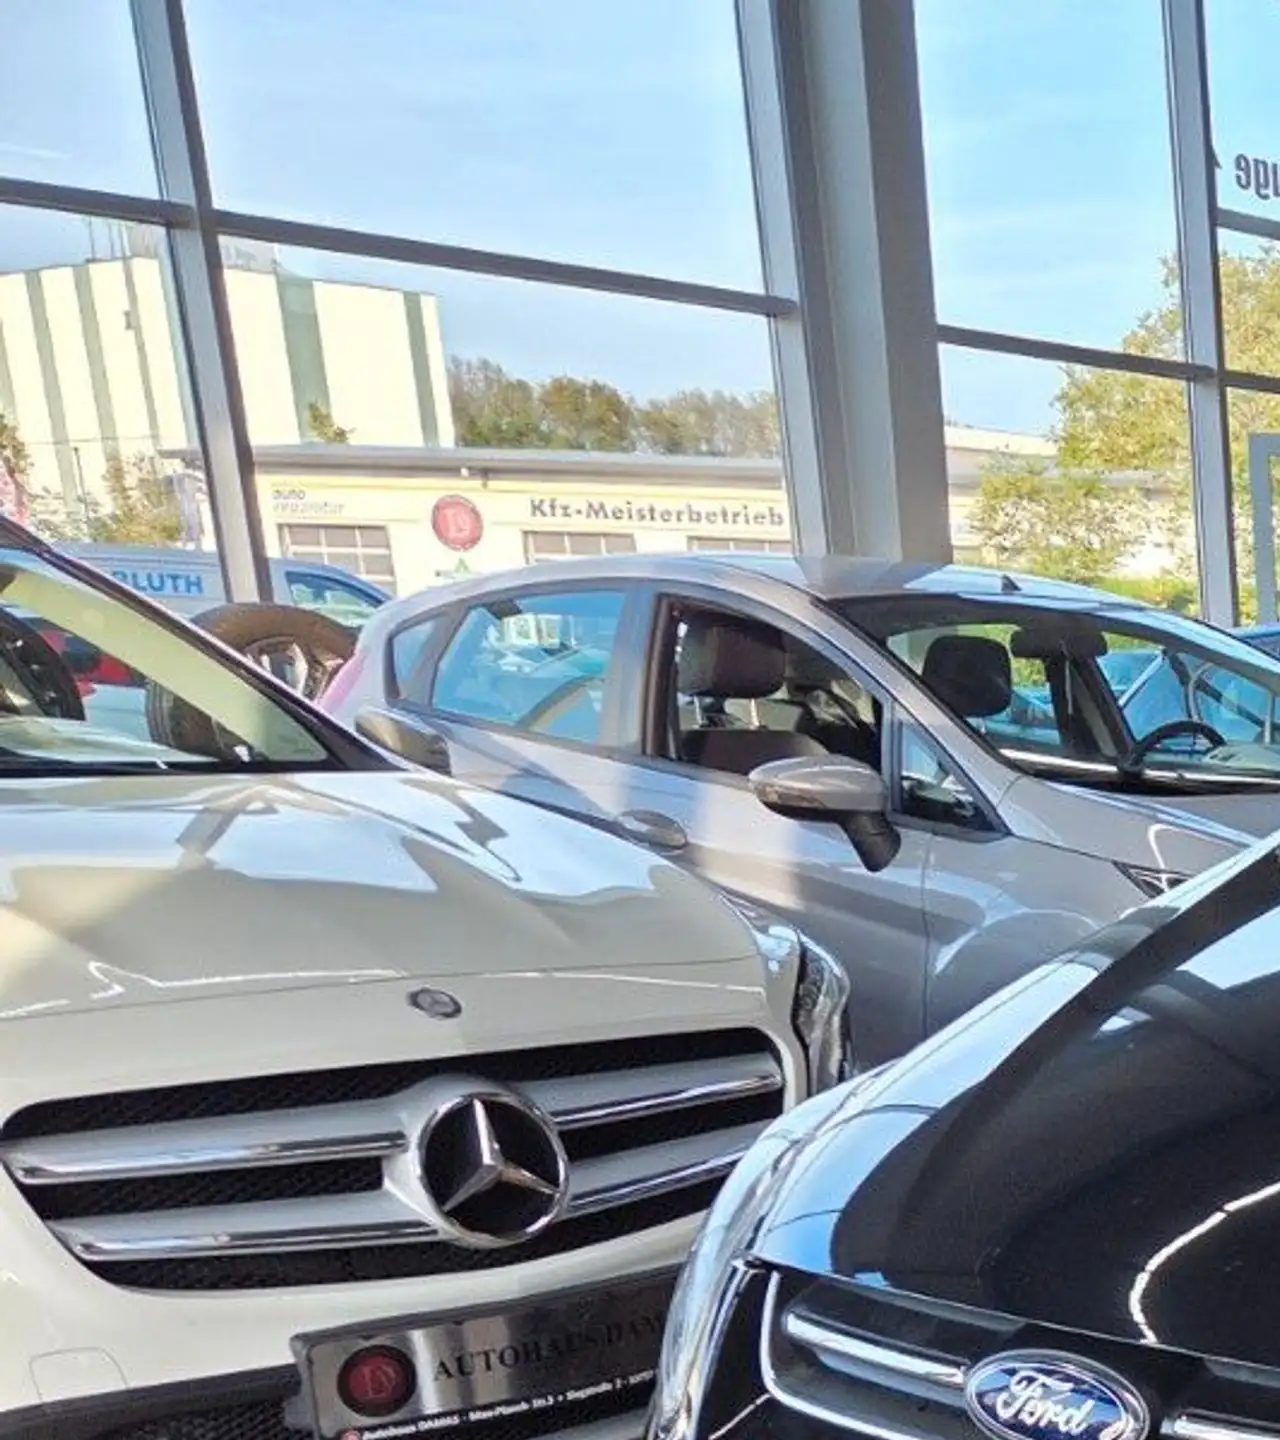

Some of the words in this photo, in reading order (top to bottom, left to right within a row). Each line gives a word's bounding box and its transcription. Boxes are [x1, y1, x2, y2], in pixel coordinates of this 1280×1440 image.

[529, 497, 785, 526] Kfz-Meisterbetrieb
[433, 1328, 601, 1382] AUTOHAUS
[996, 1369, 1096, 1436] Ford
